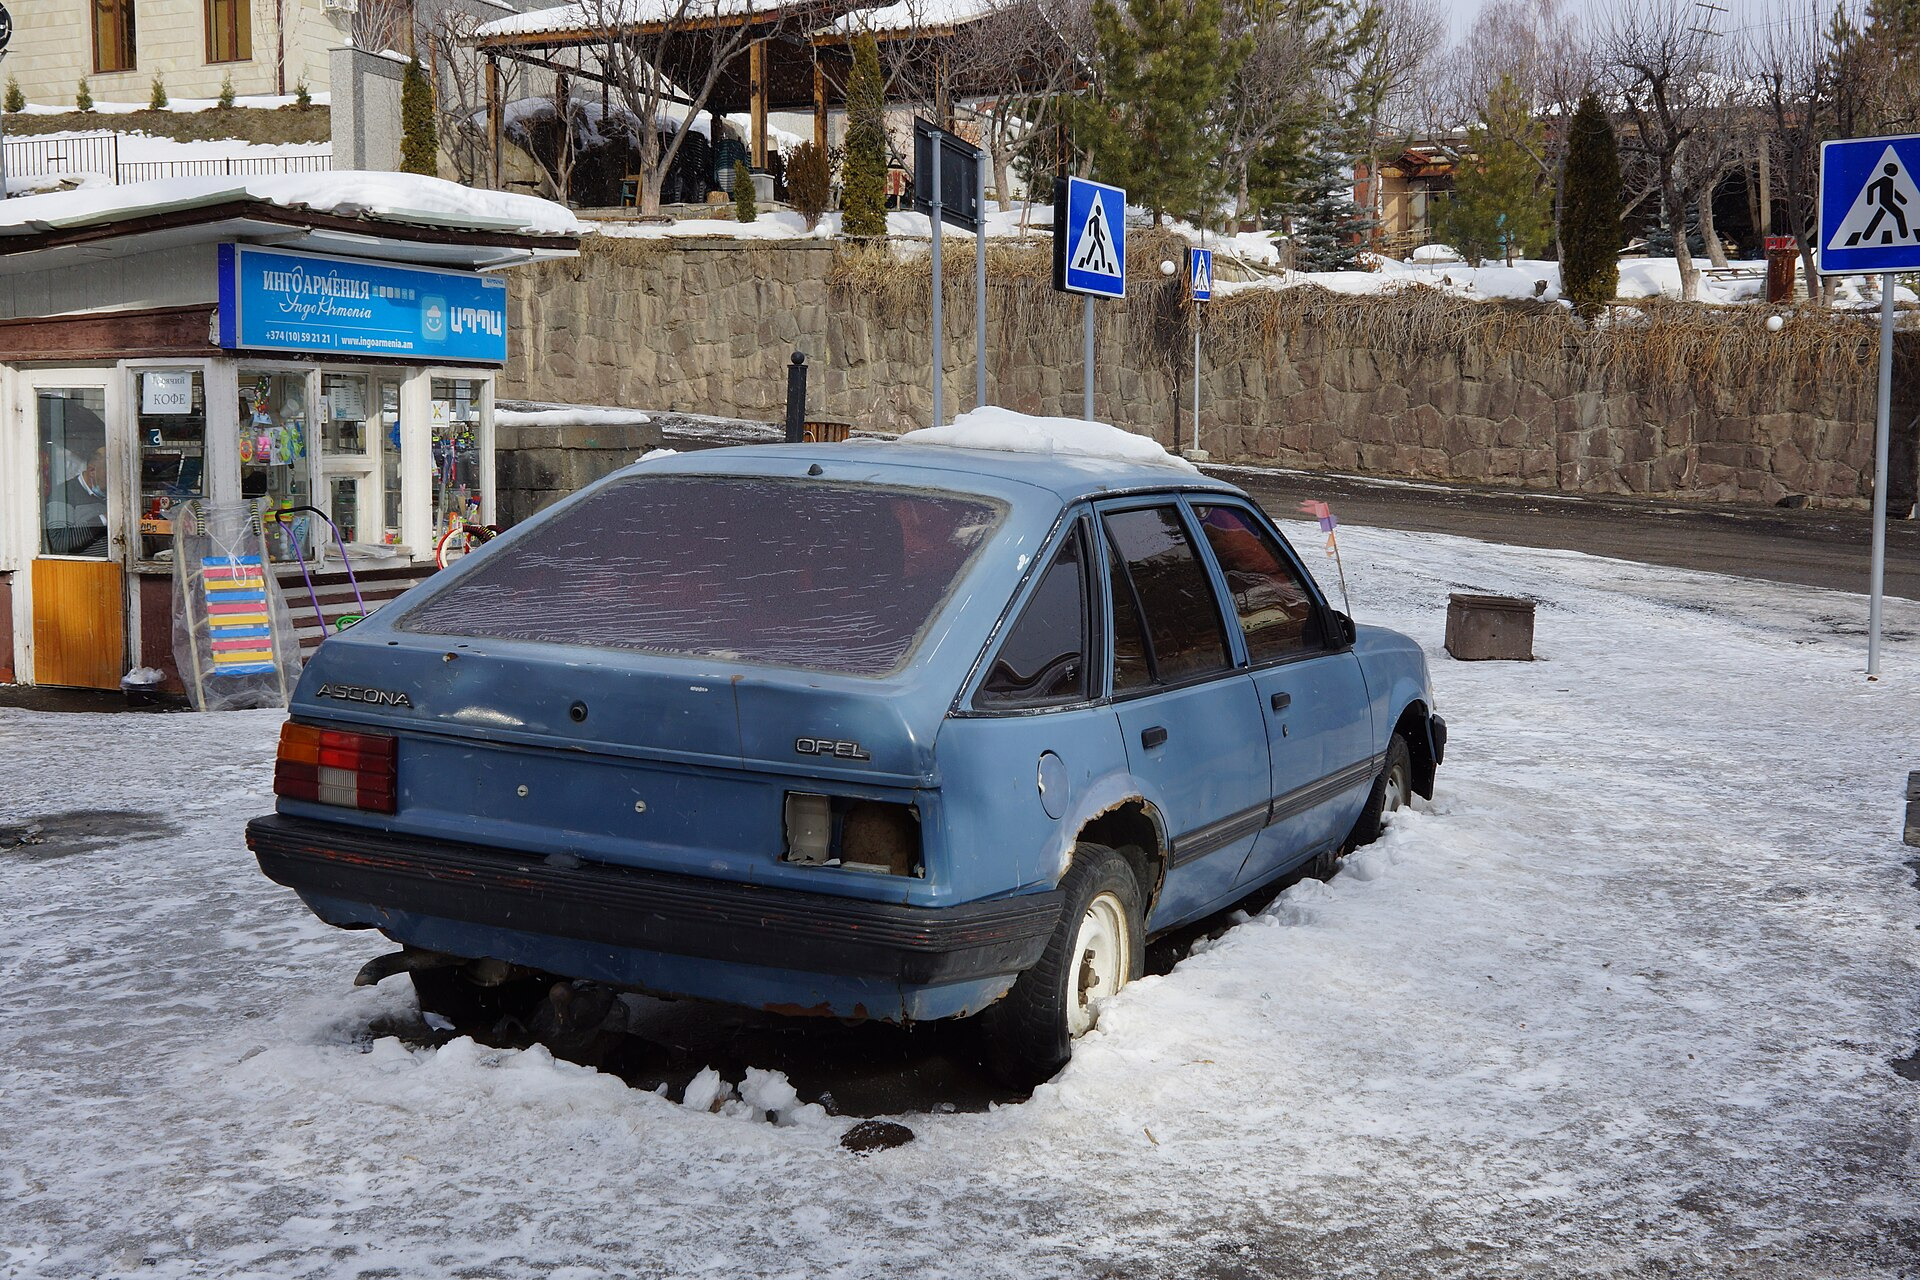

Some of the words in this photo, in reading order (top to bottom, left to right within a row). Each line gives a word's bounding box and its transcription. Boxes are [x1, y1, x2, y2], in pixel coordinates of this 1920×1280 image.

[265, 330, 286, 341] +374
[286, 331, 301, 343] (10)
[301, 332, 311, 342] 59
[311, 333, 320, 343] 21
[321, 334, 330, 344] 21
[341, 336, 414, 349] www.ingoarmenia.am
[154, 393, 186, 405] КОФЕ
[316, 683, 413, 709] ASCONA
[795, 737, 871, 761] OPEL
